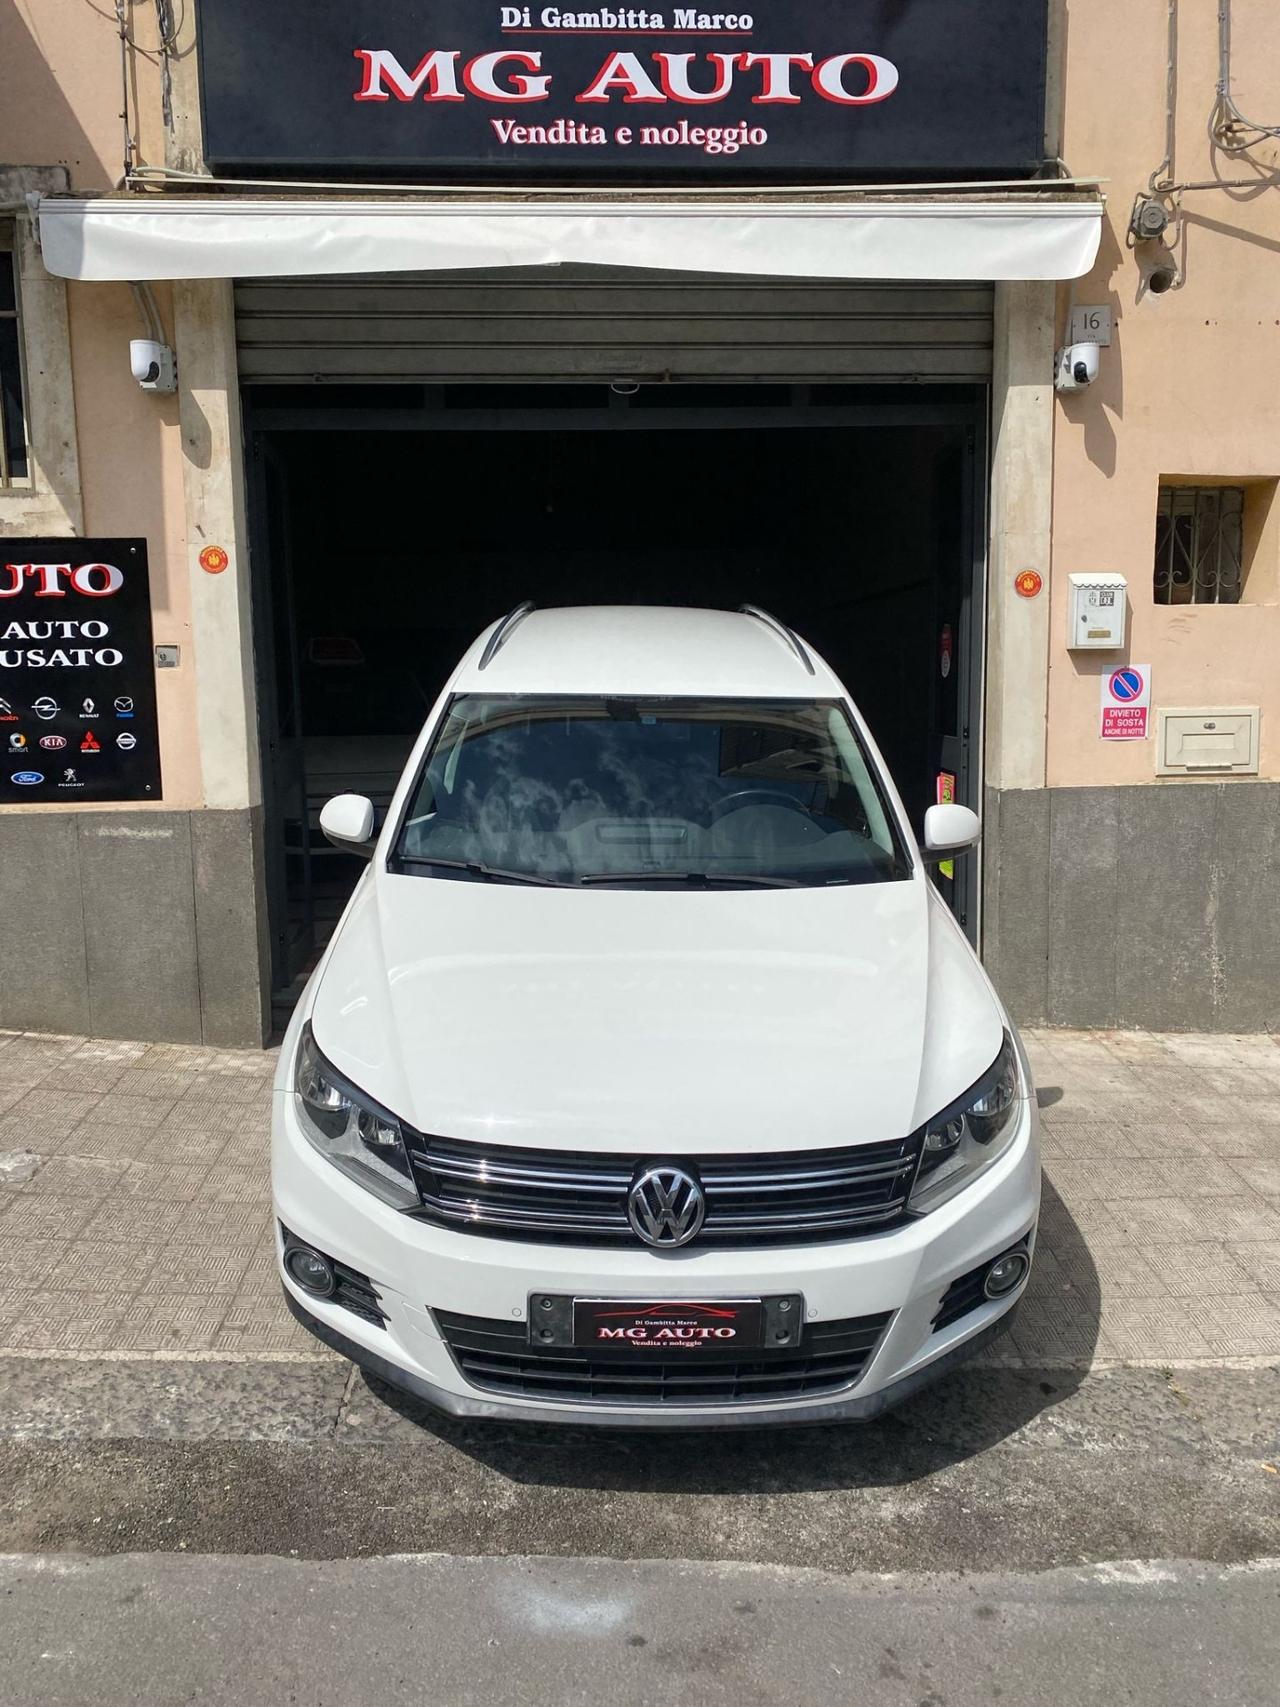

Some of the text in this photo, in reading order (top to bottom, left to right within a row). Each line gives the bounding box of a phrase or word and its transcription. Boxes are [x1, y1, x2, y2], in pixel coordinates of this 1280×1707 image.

[501, 7, 753, 30] Di Gambitta Marco
[354, 49, 899, 104] MG AUTO
[490, 119, 768, 154] Vendita e noleggio
[1084, 312, 1100, 329] 16
[1, 620, 109, 639] AUTO
[0, 648, 123, 668] USATO
[1105, 718, 1144, 727] DI SOSTA
[1110, 709, 1141, 718] DIVIETO
[598, 1327, 737, 1338] MG AUTO
